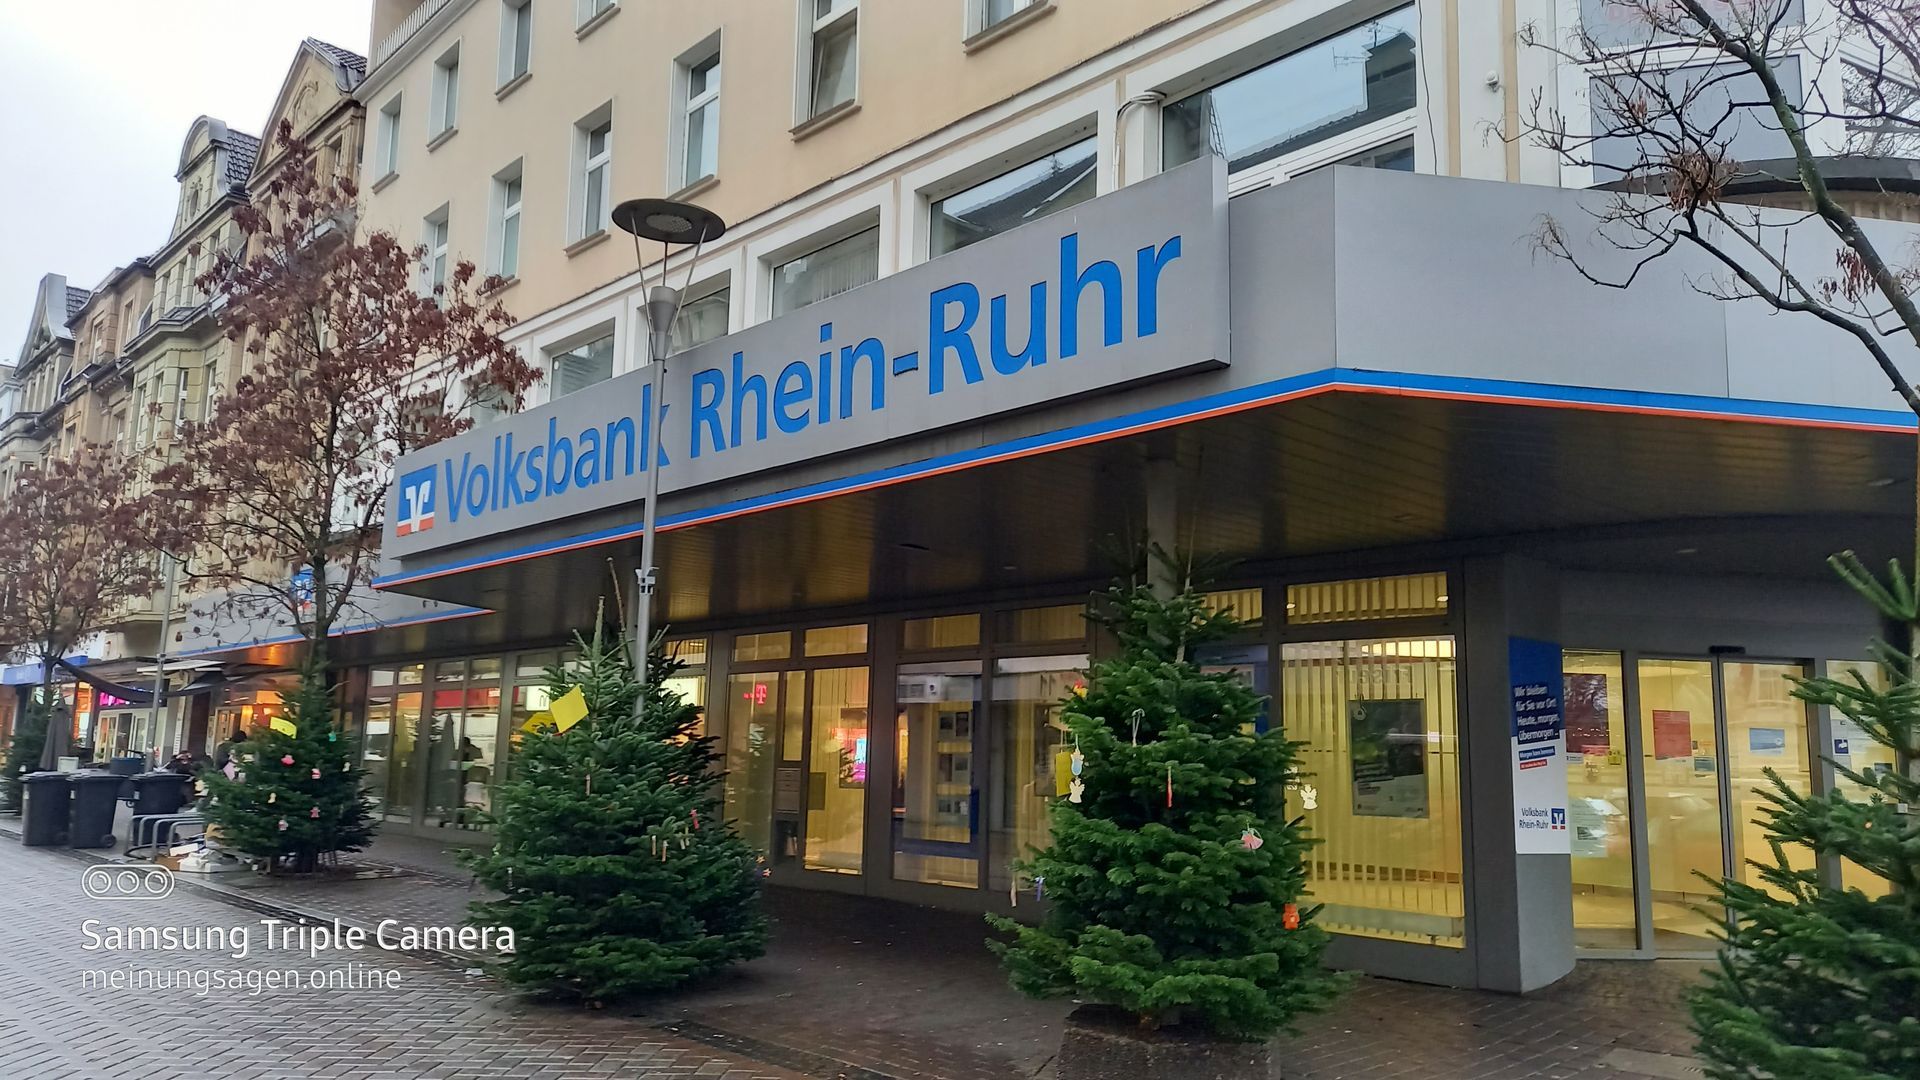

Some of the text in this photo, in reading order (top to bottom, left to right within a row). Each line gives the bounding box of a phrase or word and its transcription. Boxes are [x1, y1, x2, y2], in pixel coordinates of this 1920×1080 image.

[445, 232, 1182, 523] Volksbank Rhein-Ruhr
[1514, 684, 1548, 697] Wir bleiben
[1516, 700, 1526, 711] für
[1526, 699, 1535, 711] Sie
[1535, 700, 1545, 709] vor
[1518, 728, 1554, 741] übermorgen
[1521, 807, 1549, 817] Volksbank
[1519, 819, 1549, 829] Rhein-Ruhr
